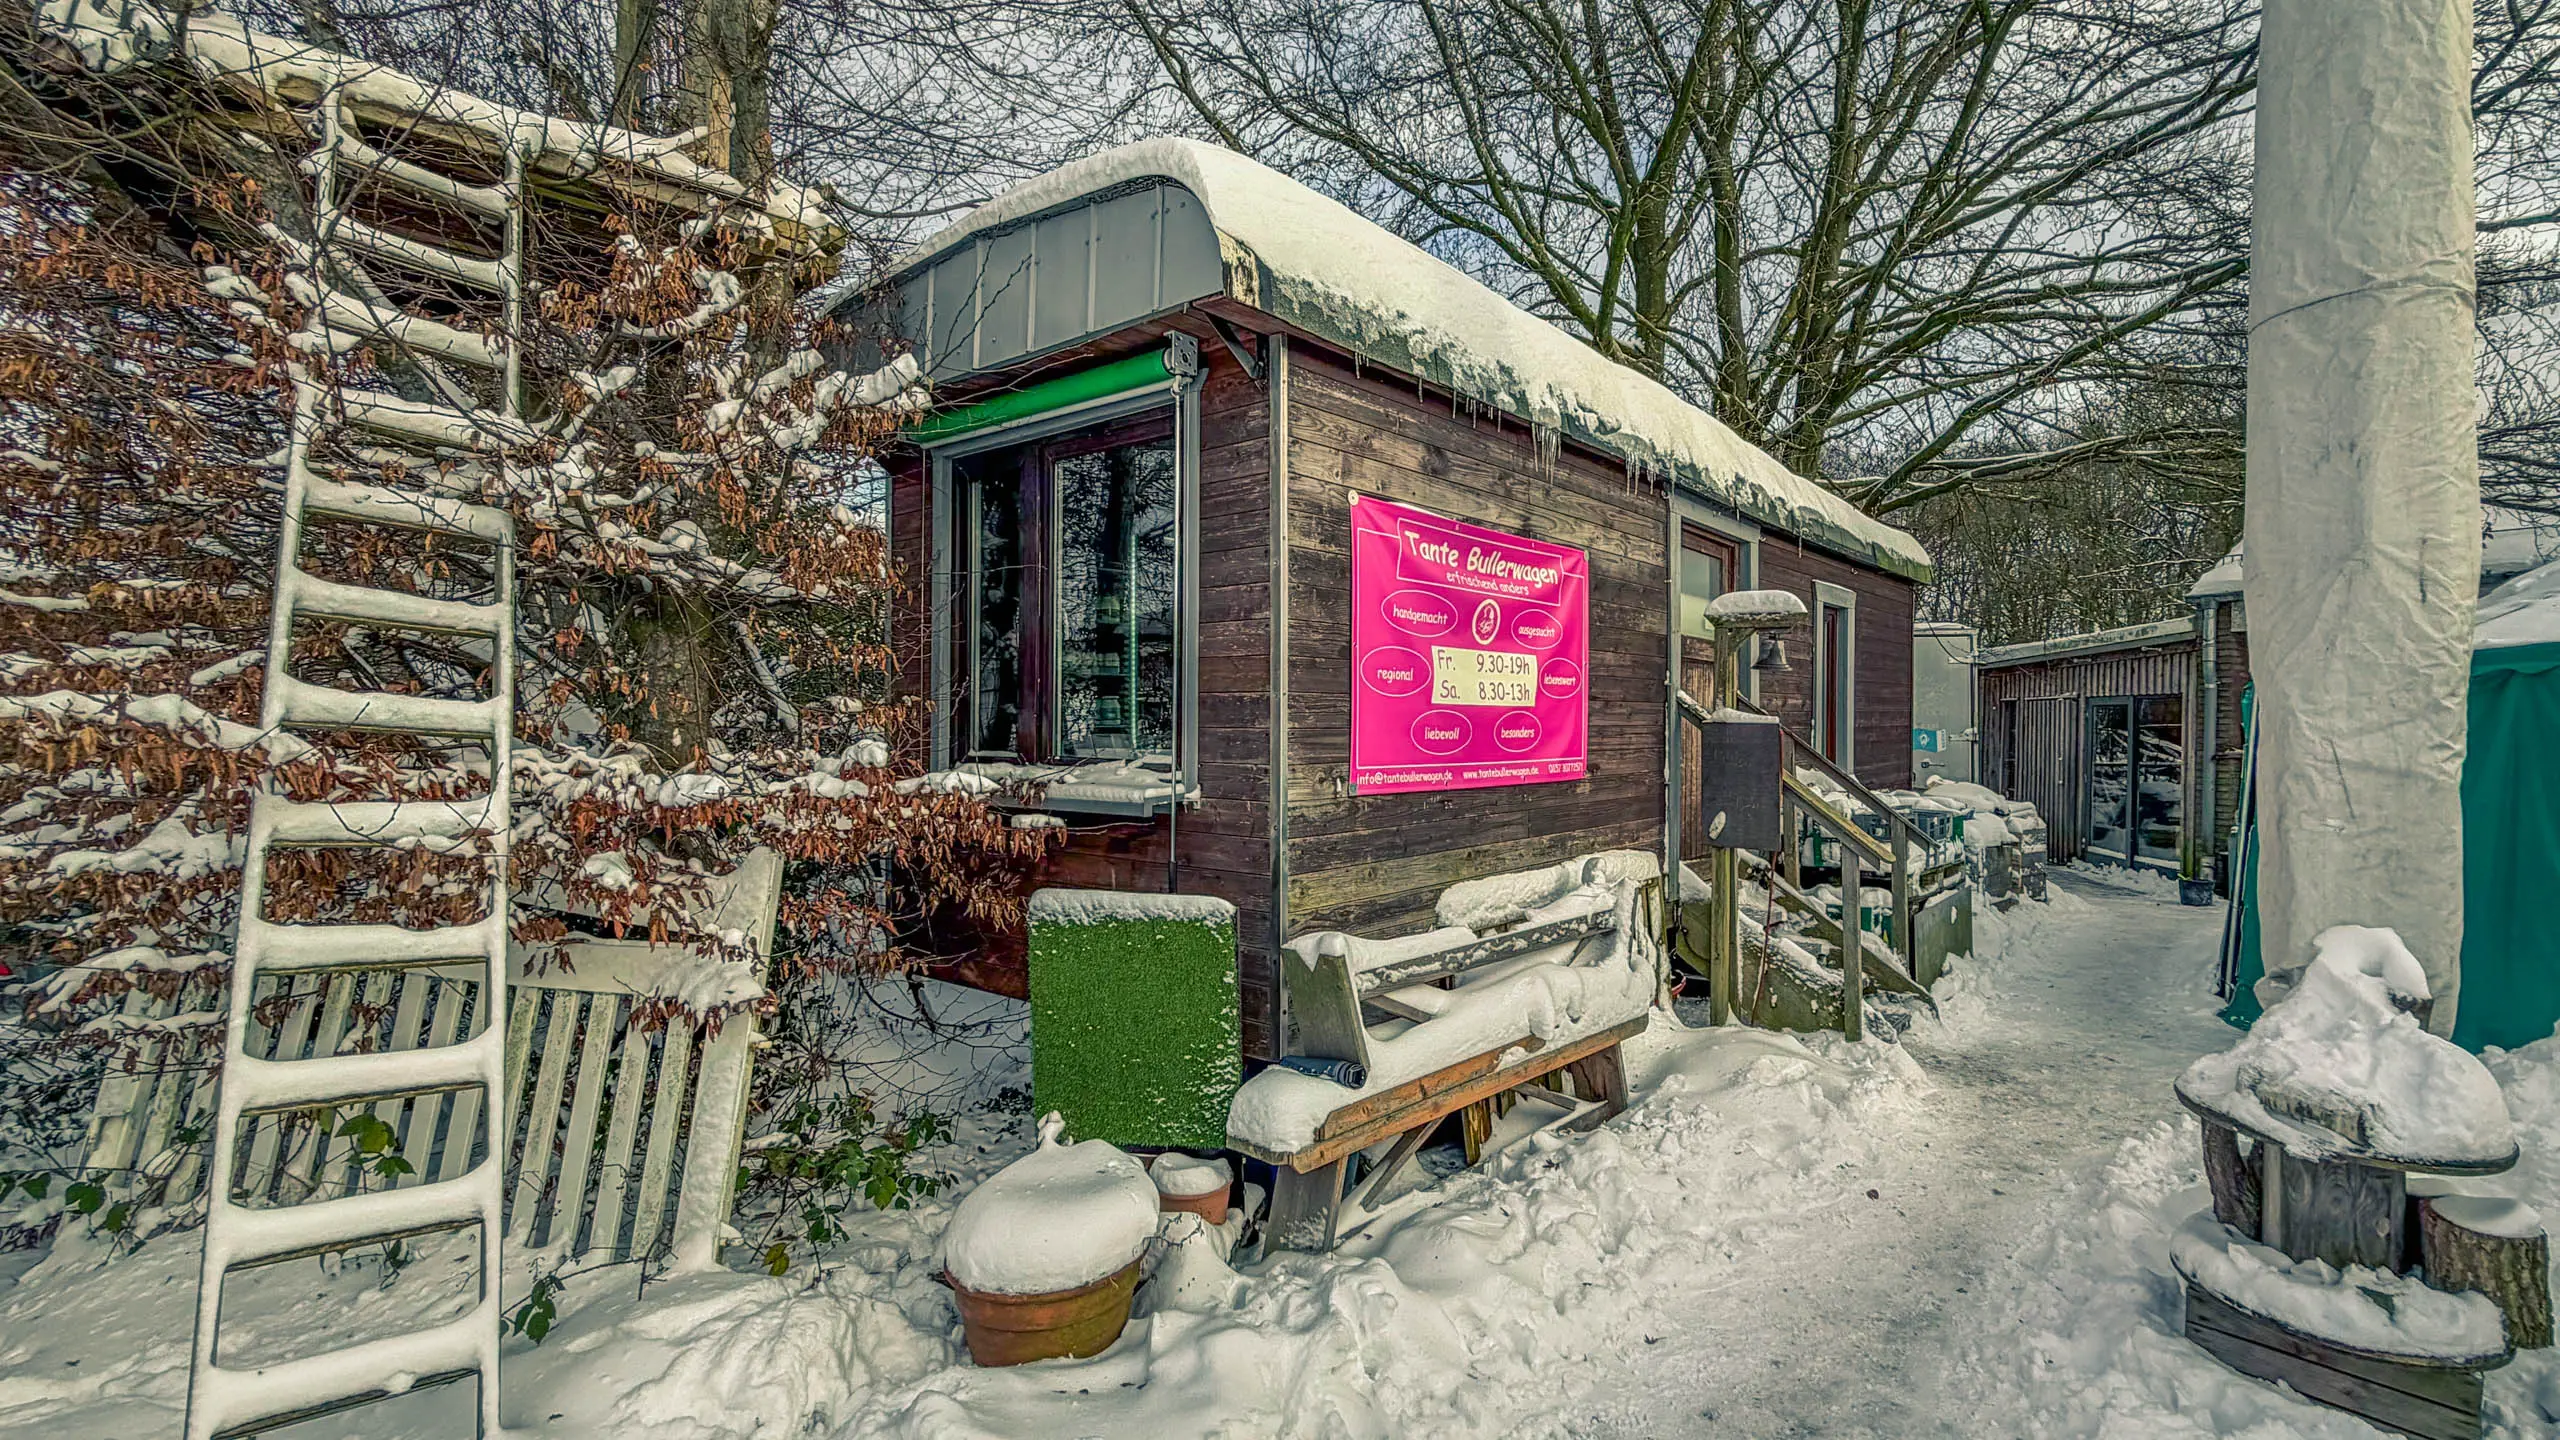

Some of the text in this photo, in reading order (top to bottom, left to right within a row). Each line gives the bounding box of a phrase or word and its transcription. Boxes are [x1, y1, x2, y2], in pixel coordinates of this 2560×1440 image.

[1404, 530, 1558, 588] Tante Bullerwagen
[1446, 571, 1529, 595] erfrischend anders
[1393, 604, 1448, 625] handgemacht
[1518, 625, 1556, 639] ausgesucht
[1437, 649, 1530, 675] Fr. 9.30-19h
[1377, 668, 1413, 683] regional
[1440, 680, 1530, 701] Sa. 8.30-13h
[1425, 727, 1460, 740] liebevoll
[1501, 726, 1535, 738] besonders
[1356, 769, 1453, 785] info@tantebullerwagen.de
[1463, 765, 1539, 779] www.tantebullerwagen.de
